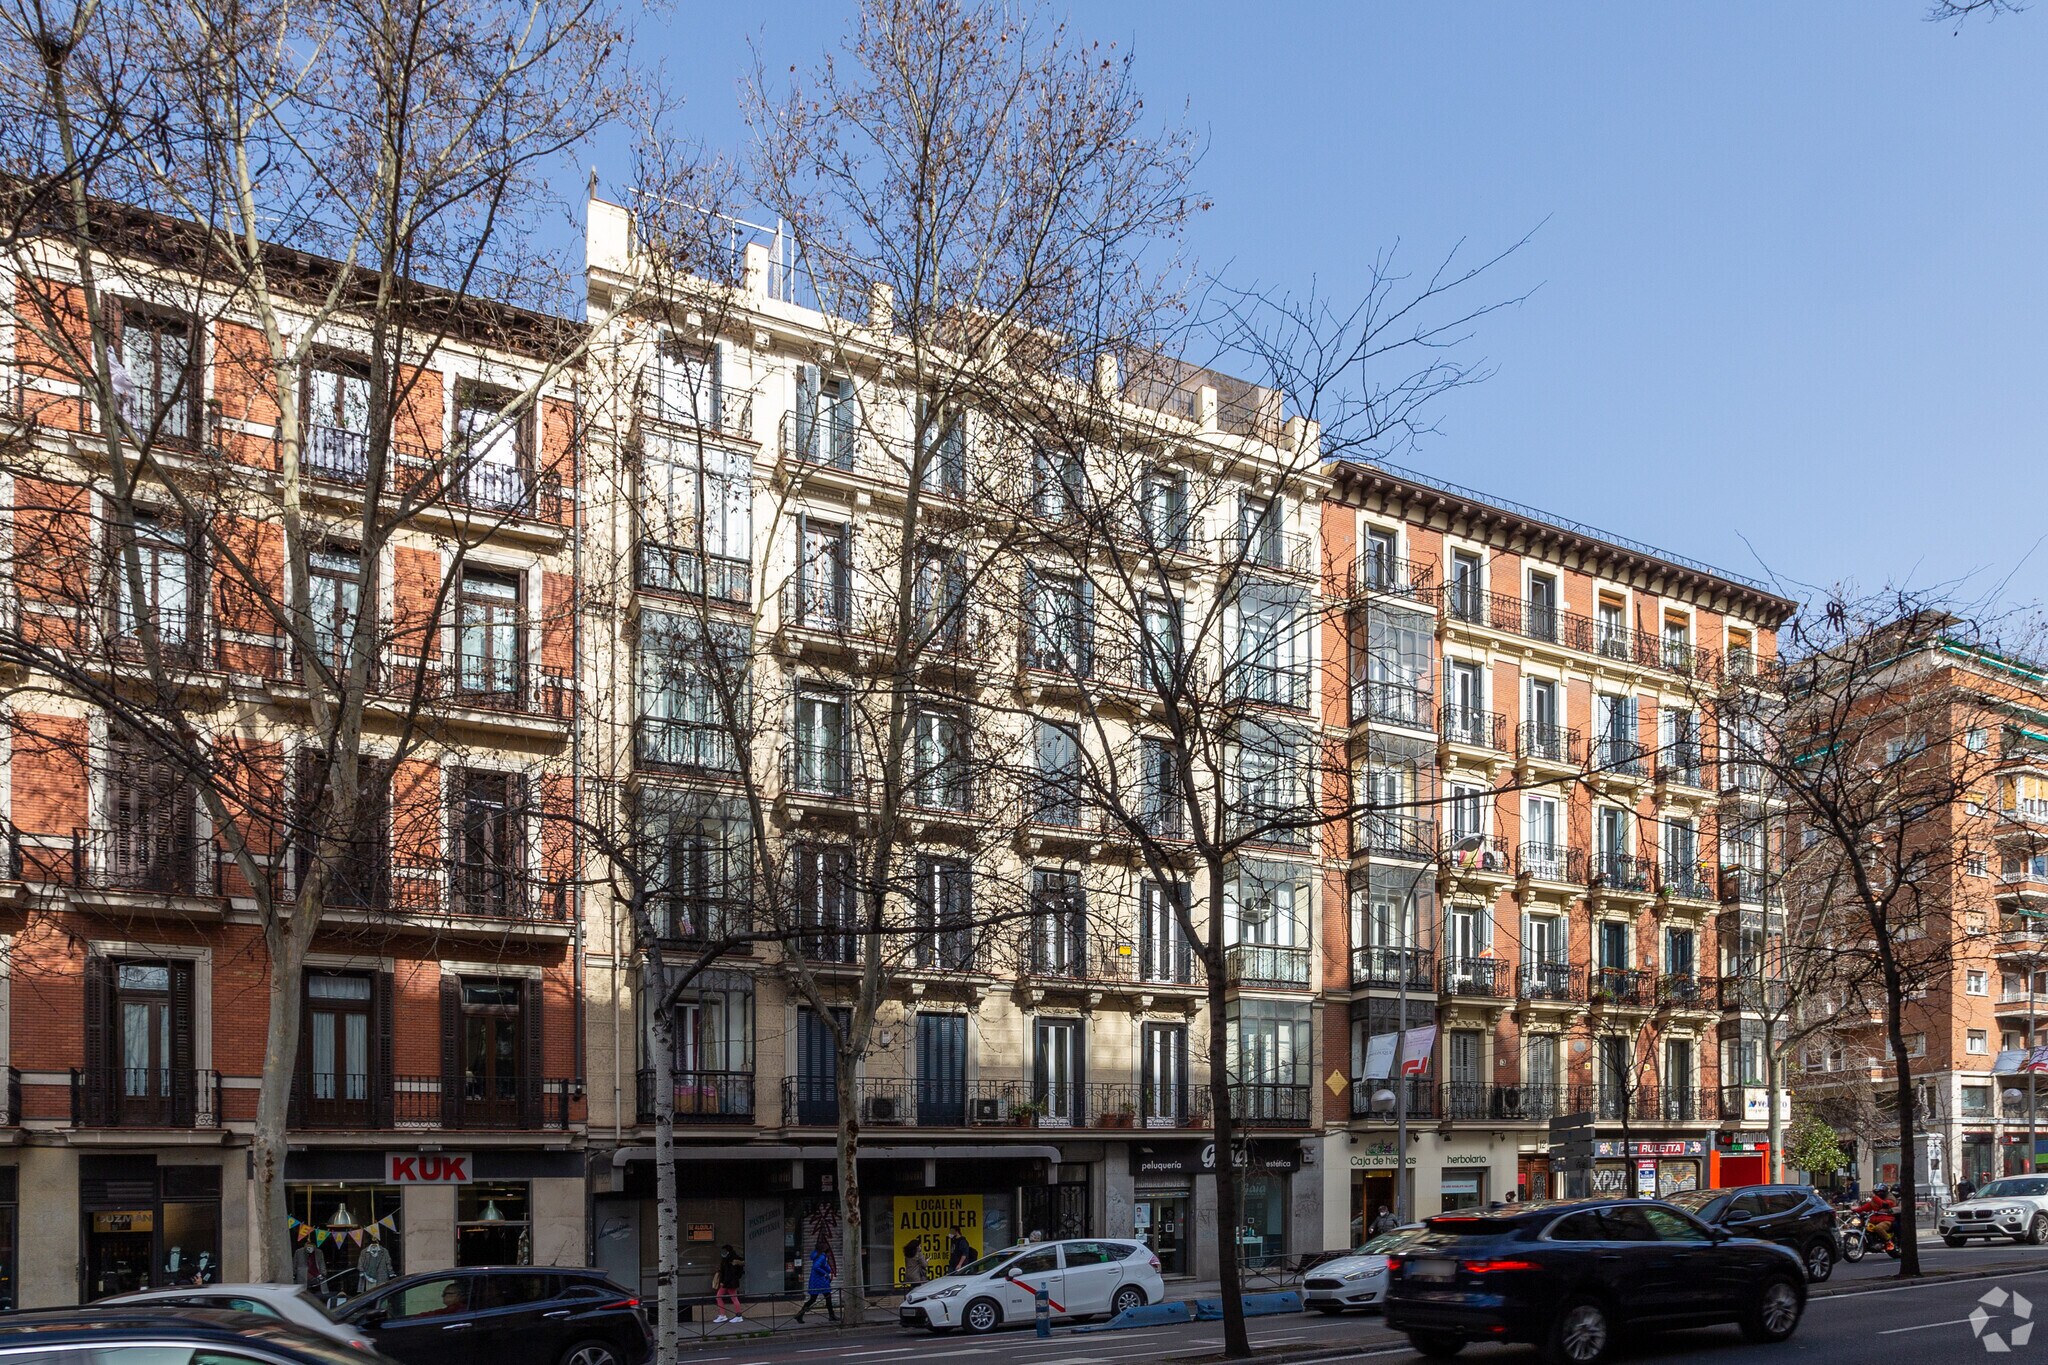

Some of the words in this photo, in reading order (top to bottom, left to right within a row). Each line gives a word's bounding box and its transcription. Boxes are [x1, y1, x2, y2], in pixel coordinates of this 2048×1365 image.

[1641, 1143, 1682, 1153] RULETTA
[1265, 1159, 1292, 1168] estética
[1350, 1156, 1371, 1168] Caja
[1372, 1156, 1384, 1165] de
[1385, 1156, 1417, 1165] hieas
[1447, 1154, 1487, 1164] herbolario
[393, 1157, 466, 1181] KUK
[1141, 1160, 1182, 1171] peluquería
[916, 1199, 947, 1211] LOCAL
[950, 1198, 962, 1210] EN
[900, 1210, 977, 1231] ALQUILER
